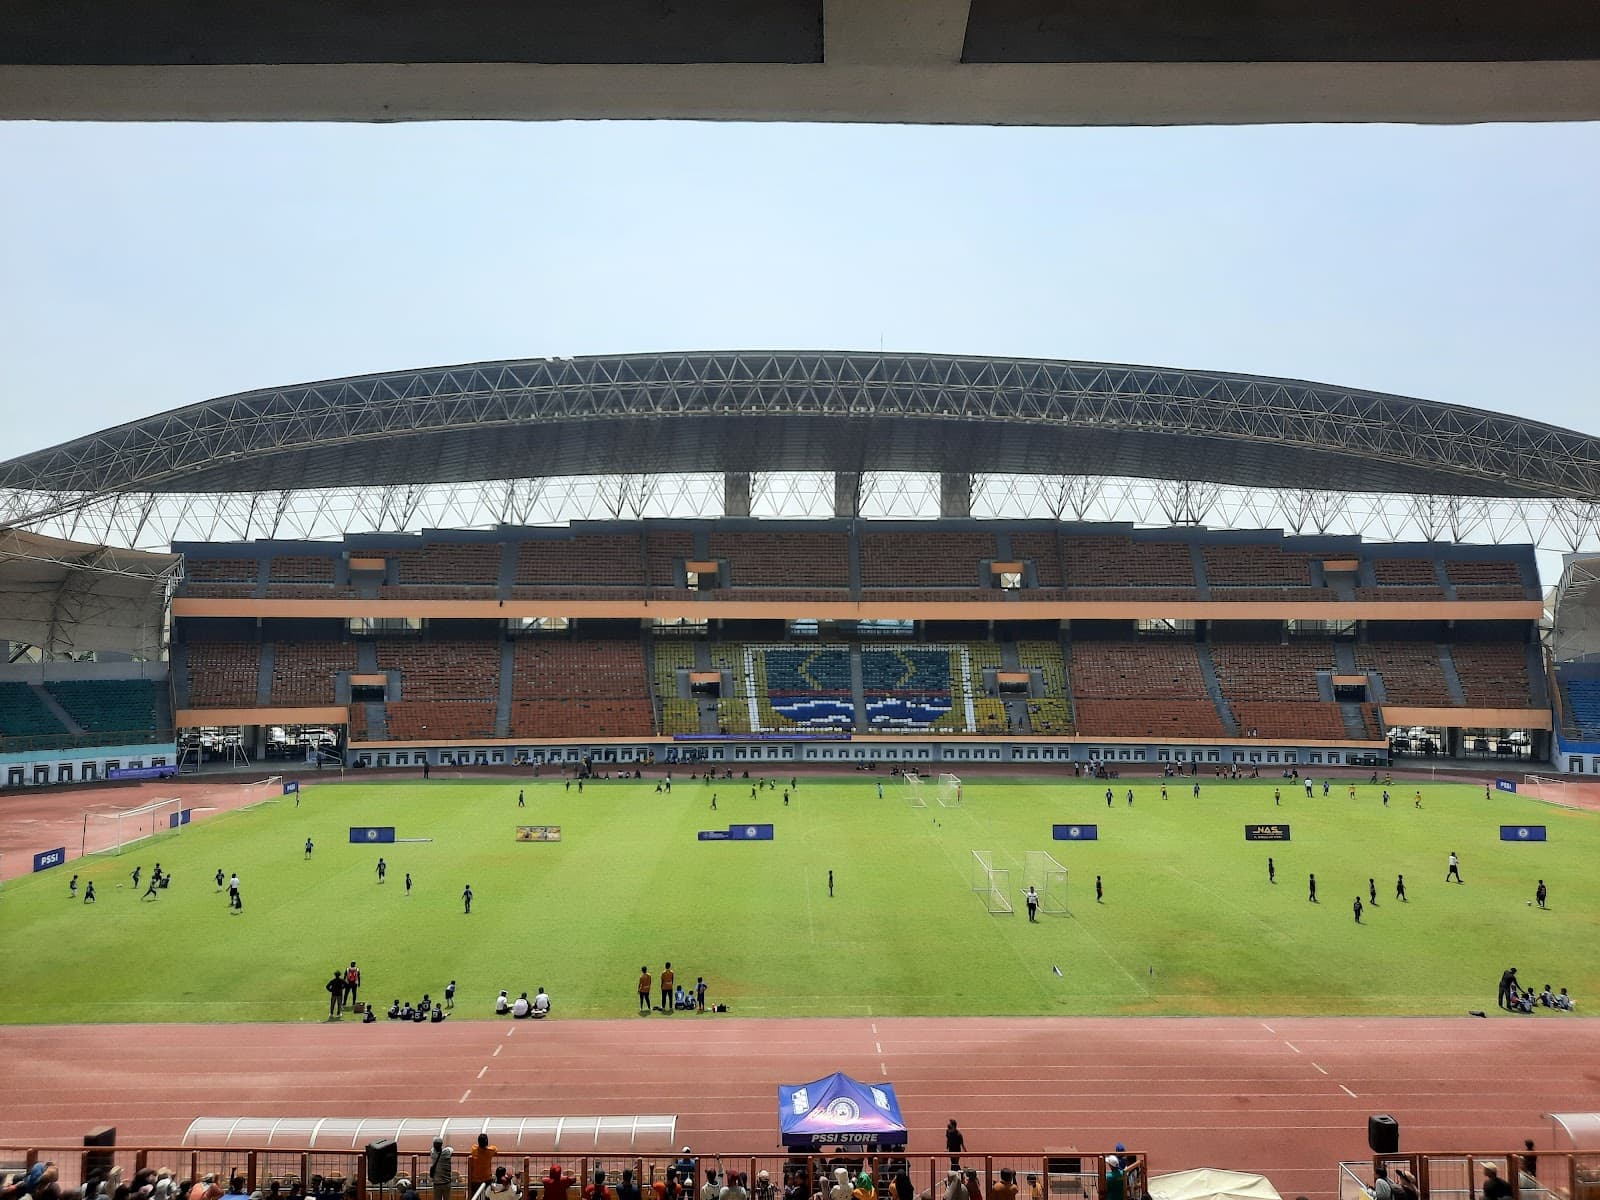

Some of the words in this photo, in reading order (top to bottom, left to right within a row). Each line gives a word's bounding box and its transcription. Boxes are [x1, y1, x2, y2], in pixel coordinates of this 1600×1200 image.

[41, 853, 59, 865] PSSI
[811, 1133, 839, 1143] PSSI
[840, 1133, 879, 1143] STORE
